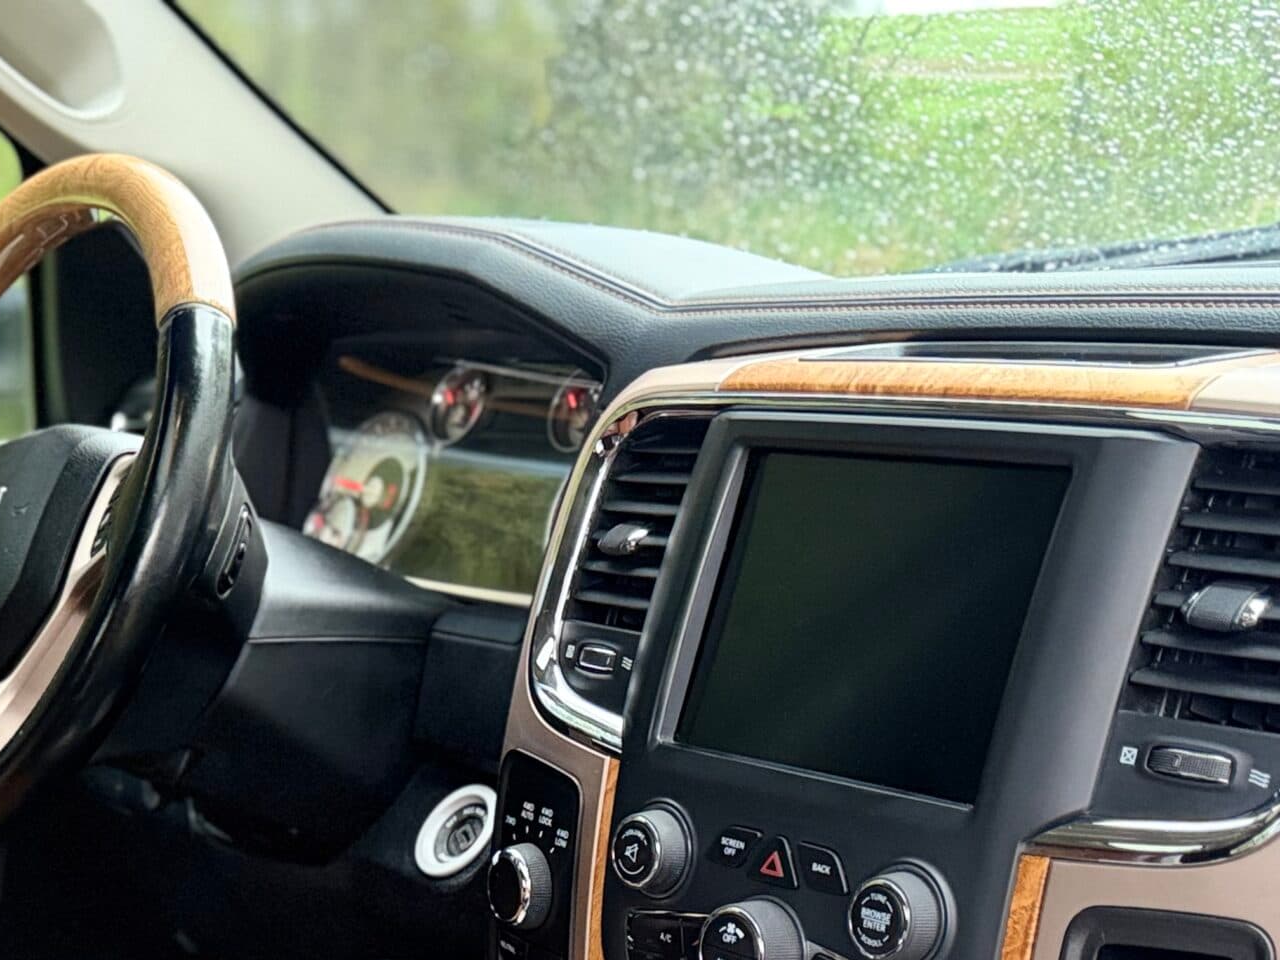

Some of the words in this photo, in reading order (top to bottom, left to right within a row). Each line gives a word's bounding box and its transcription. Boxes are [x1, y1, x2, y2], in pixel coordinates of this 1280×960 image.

[538, 815, 552, 827] LOCK
[721, 836, 745, 849] SCREEN
[723, 847, 736, 856] OFF
[812, 862, 831, 875] BACK
[861, 907, 891, 921] BROWSE
[863, 918, 886, 932] ENTER
[660, 932, 672, 943] A/C
[722, 933, 737, 944] OFF
